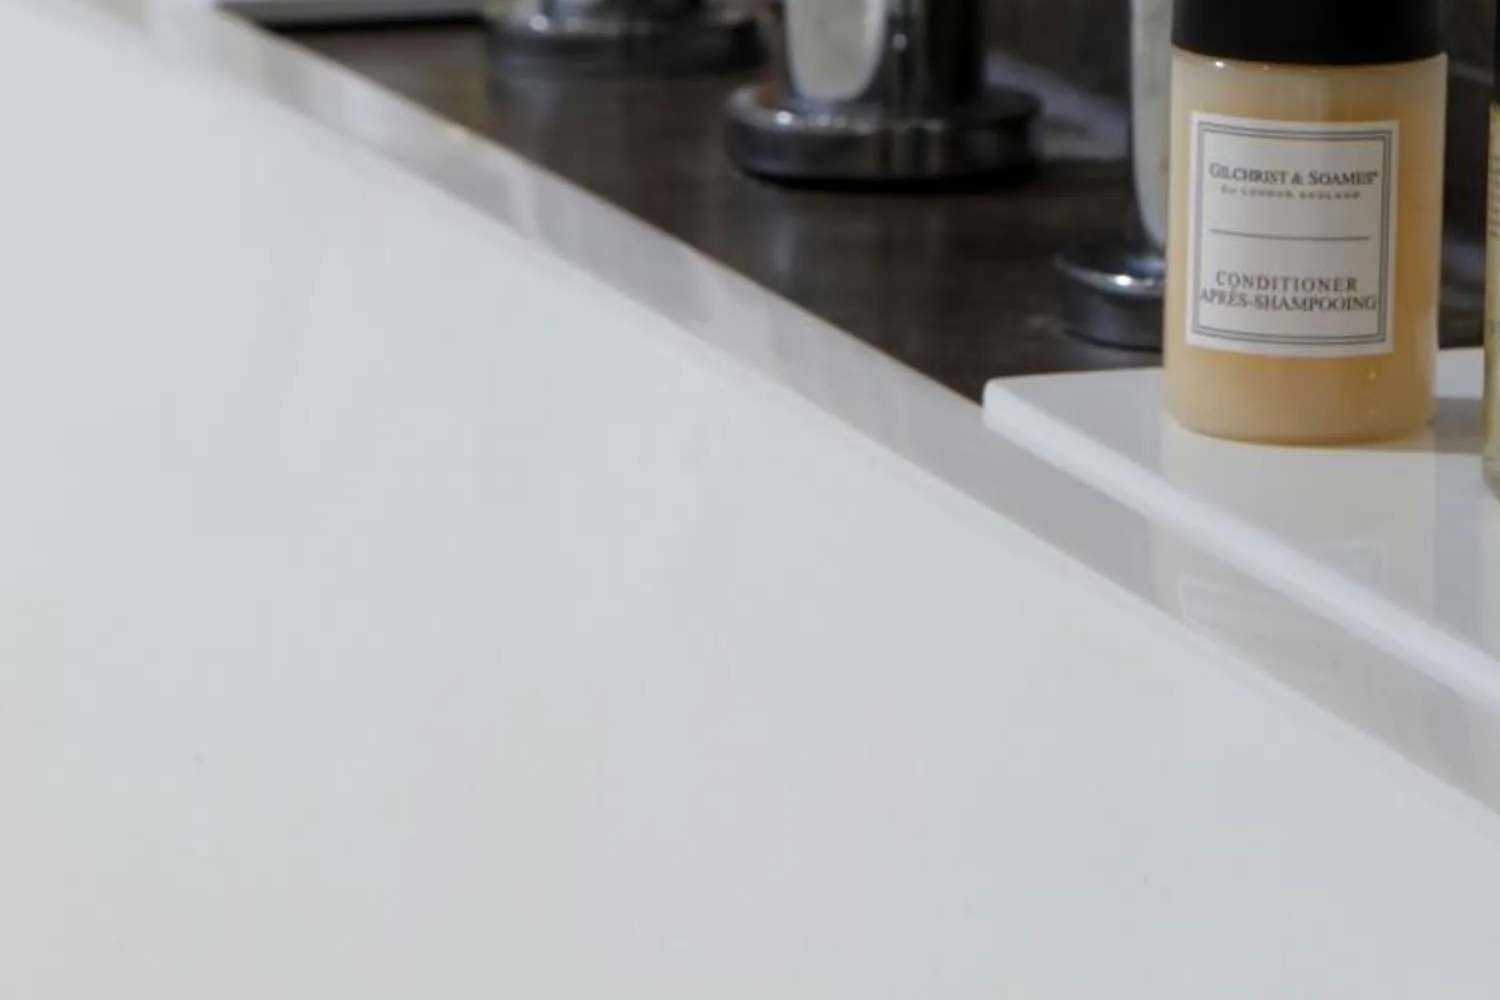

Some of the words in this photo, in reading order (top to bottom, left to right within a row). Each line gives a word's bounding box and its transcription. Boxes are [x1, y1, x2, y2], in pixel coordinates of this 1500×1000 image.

[1209, 162, 1288, 185] GILCHRIST
[1291, 169, 1304, 185] &
[1216, 270, 1358, 292] CONDITIONER
